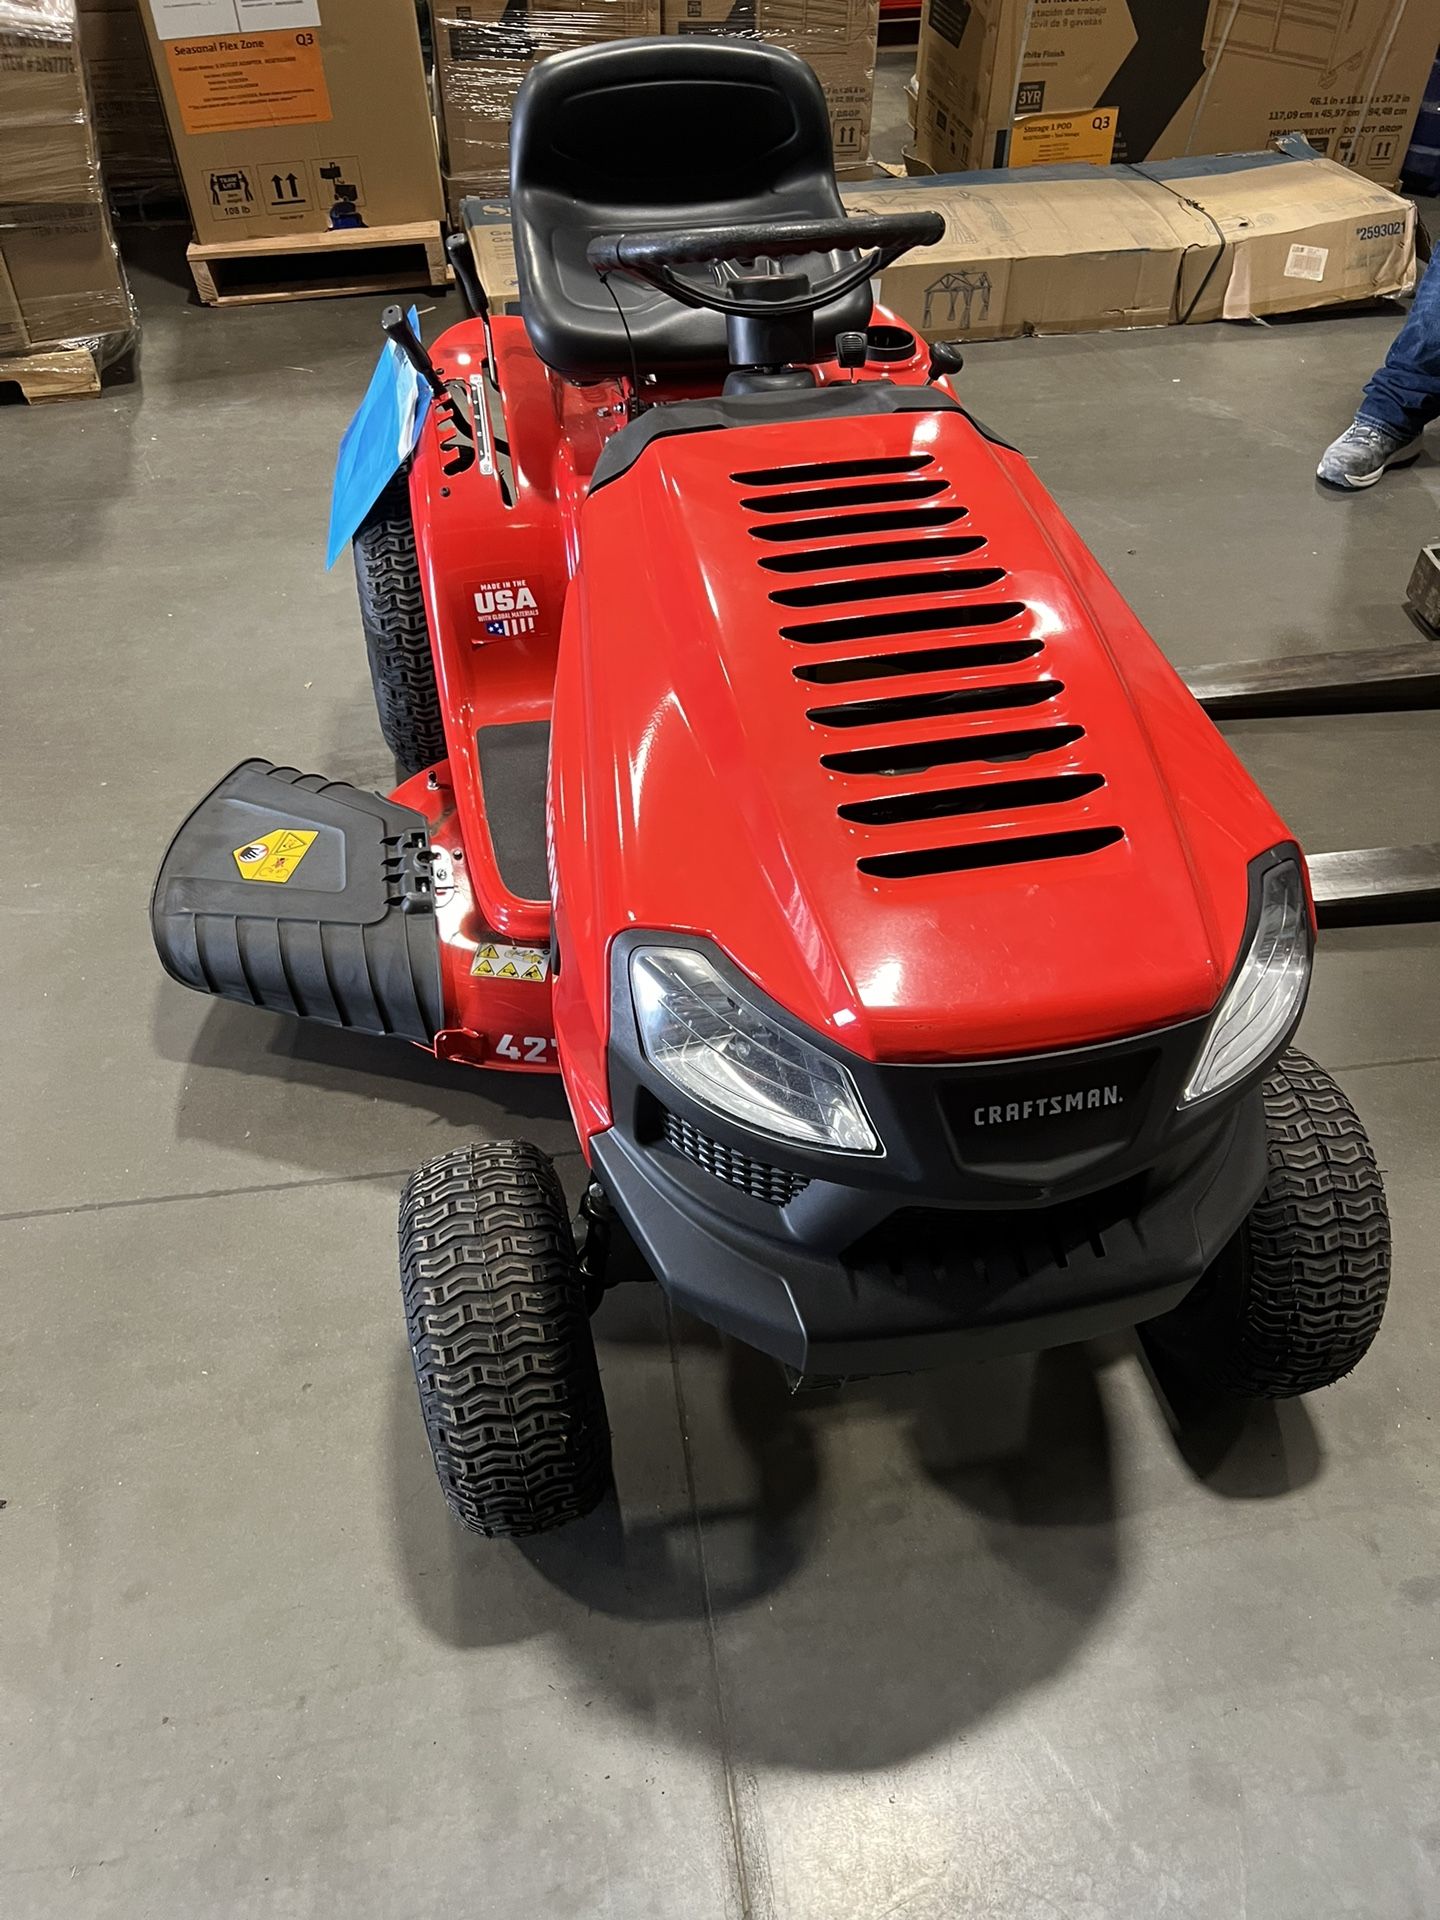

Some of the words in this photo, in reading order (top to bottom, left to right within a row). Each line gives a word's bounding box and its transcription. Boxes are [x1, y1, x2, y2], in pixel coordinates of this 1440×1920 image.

[295, 33, 314, 46] Q3
[174, 44, 218, 56] Seasonal
[219, 41, 239, 51] Flex
[241, 39, 265, 49] Zone
[1018, 90, 1041, 104] 3YR
[1300, 111, 1313, 119] cm
[1394, 107, 1408, 116] cm
[1092, 116, 1110, 131] Q3
[241, 205, 251, 214] lb
[474, 587, 538, 614] USA
[512, 609, 539, 618] MATERIALS
